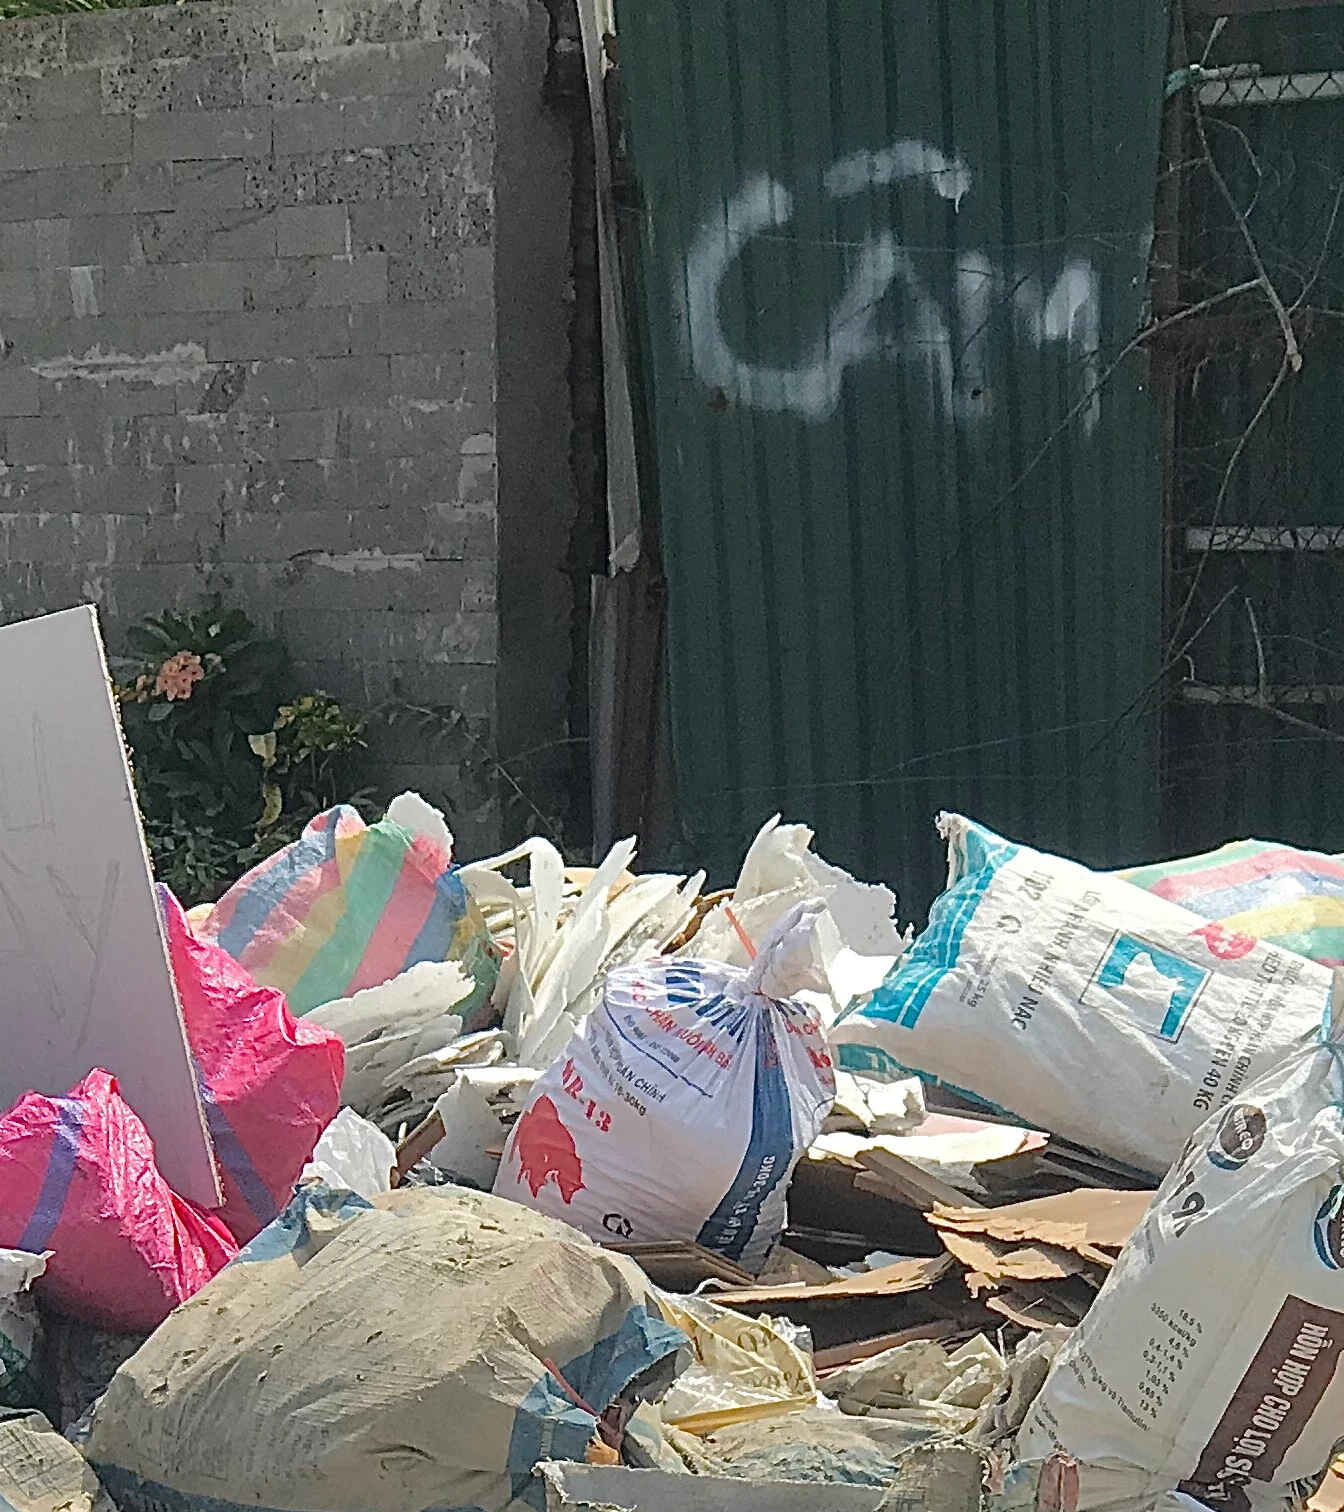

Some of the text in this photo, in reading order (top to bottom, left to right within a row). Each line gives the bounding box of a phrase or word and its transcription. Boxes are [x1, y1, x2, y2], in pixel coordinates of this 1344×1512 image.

[1005, 992, 1040, 1032] NẠC
[1201, 1066, 1224, 1090] 40
[1191, 1086, 1215, 1113] KG
[1263, 1351, 1313, 1401] HỢP
[1249, 1389, 1292, 1435] CHO
